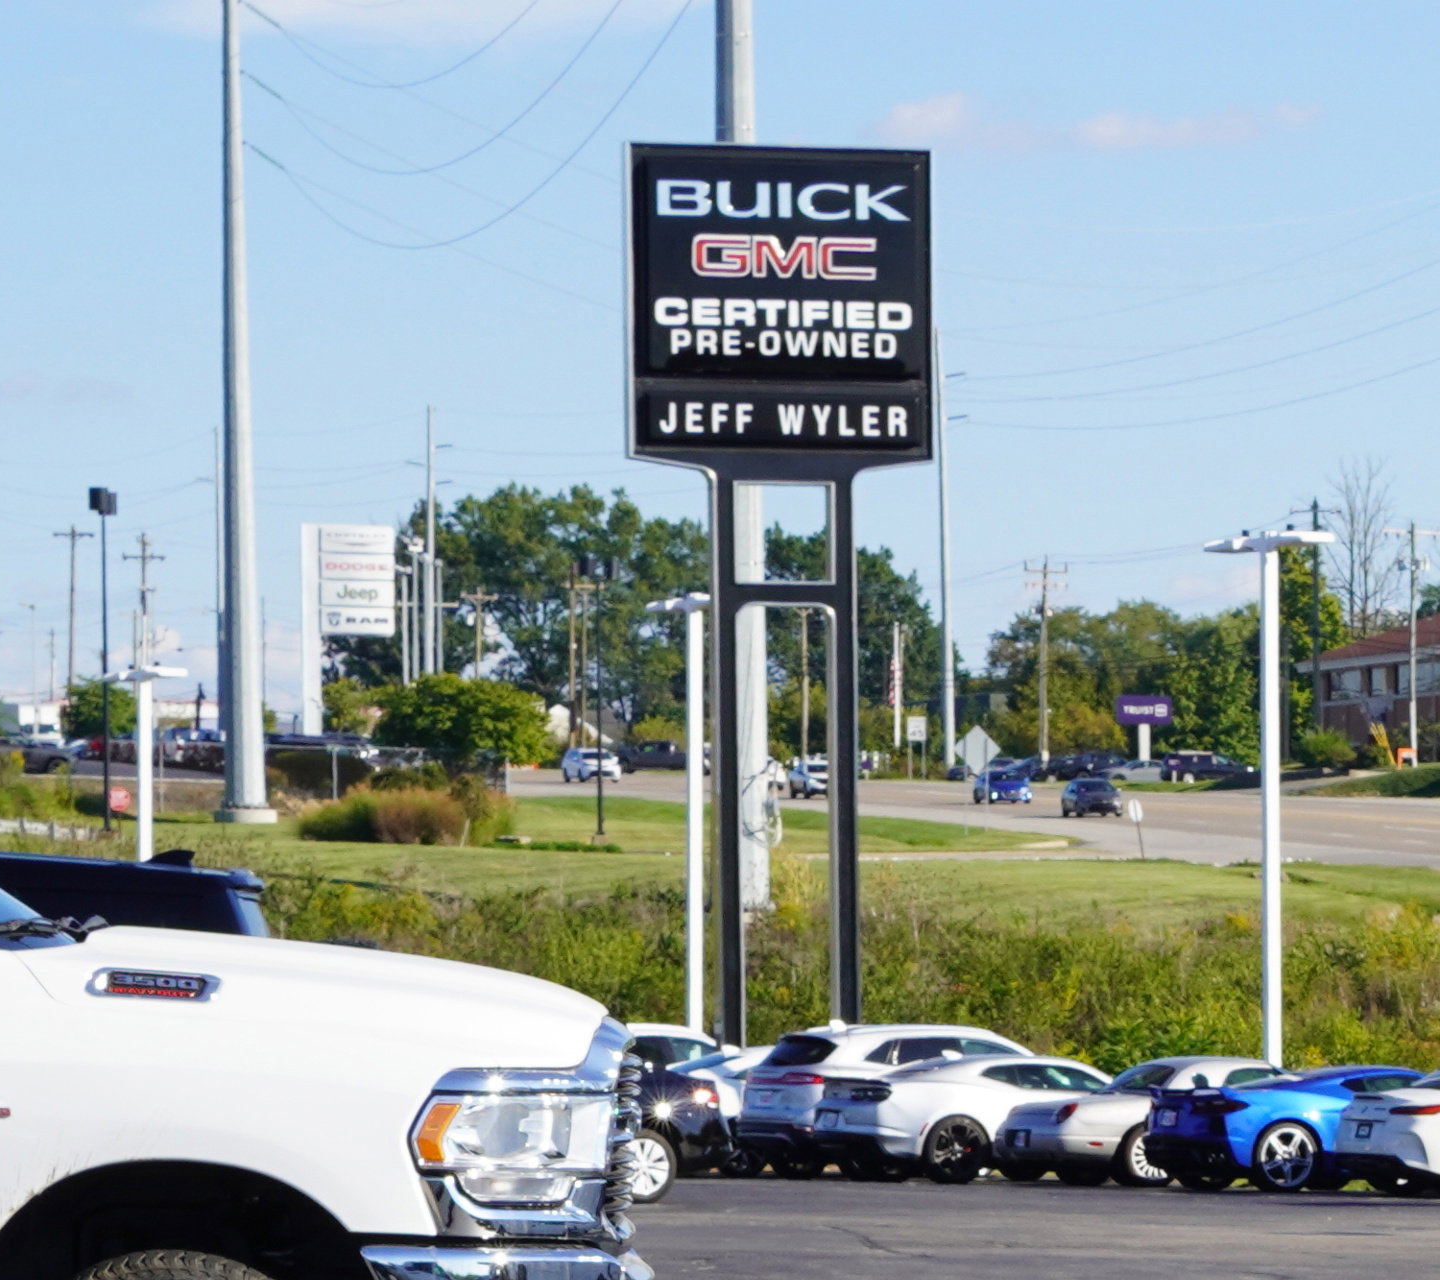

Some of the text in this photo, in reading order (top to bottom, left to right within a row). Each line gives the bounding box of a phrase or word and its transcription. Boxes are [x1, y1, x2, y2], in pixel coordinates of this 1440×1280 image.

[656, 179, 910, 221] BUICK
[692, 233, 877, 280] GMC
[654, 297, 912, 330] CERTIFIED
[670, 328, 897, 359] PRE-OWNED
[659, 402, 907, 437] JEFF WYLER
[325, 562, 388, 571] DODGE
[336, 584, 379, 602] Jeep
